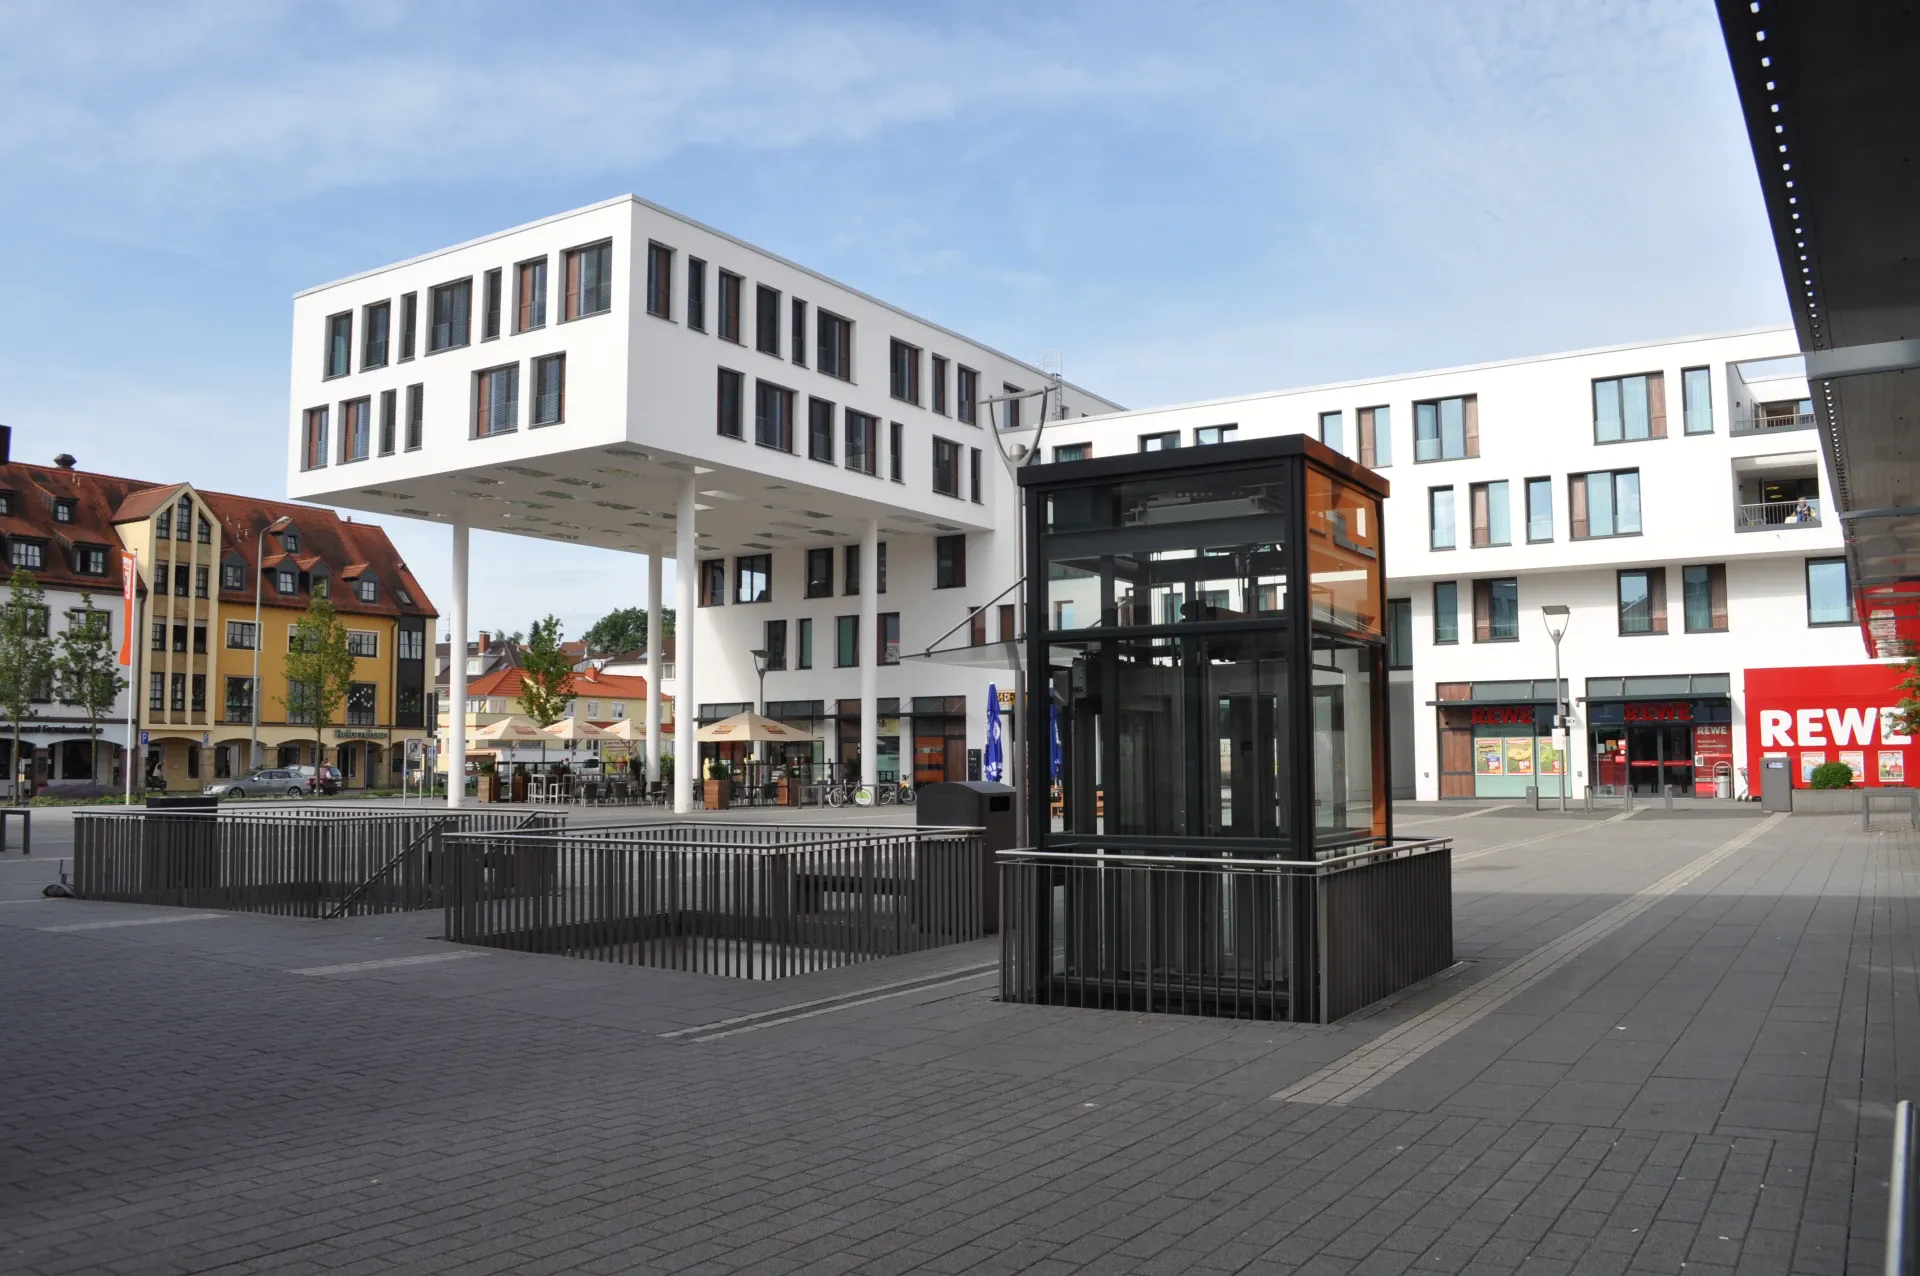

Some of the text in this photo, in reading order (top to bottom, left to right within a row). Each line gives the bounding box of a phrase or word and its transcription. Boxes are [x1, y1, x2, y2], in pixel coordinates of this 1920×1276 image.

[1472, 706, 1533, 725] REWE
[1624, 703, 1693, 721] REWE
[1697, 726, 1728, 735] REWE
[1760, 707, 1912, 747] REWE
